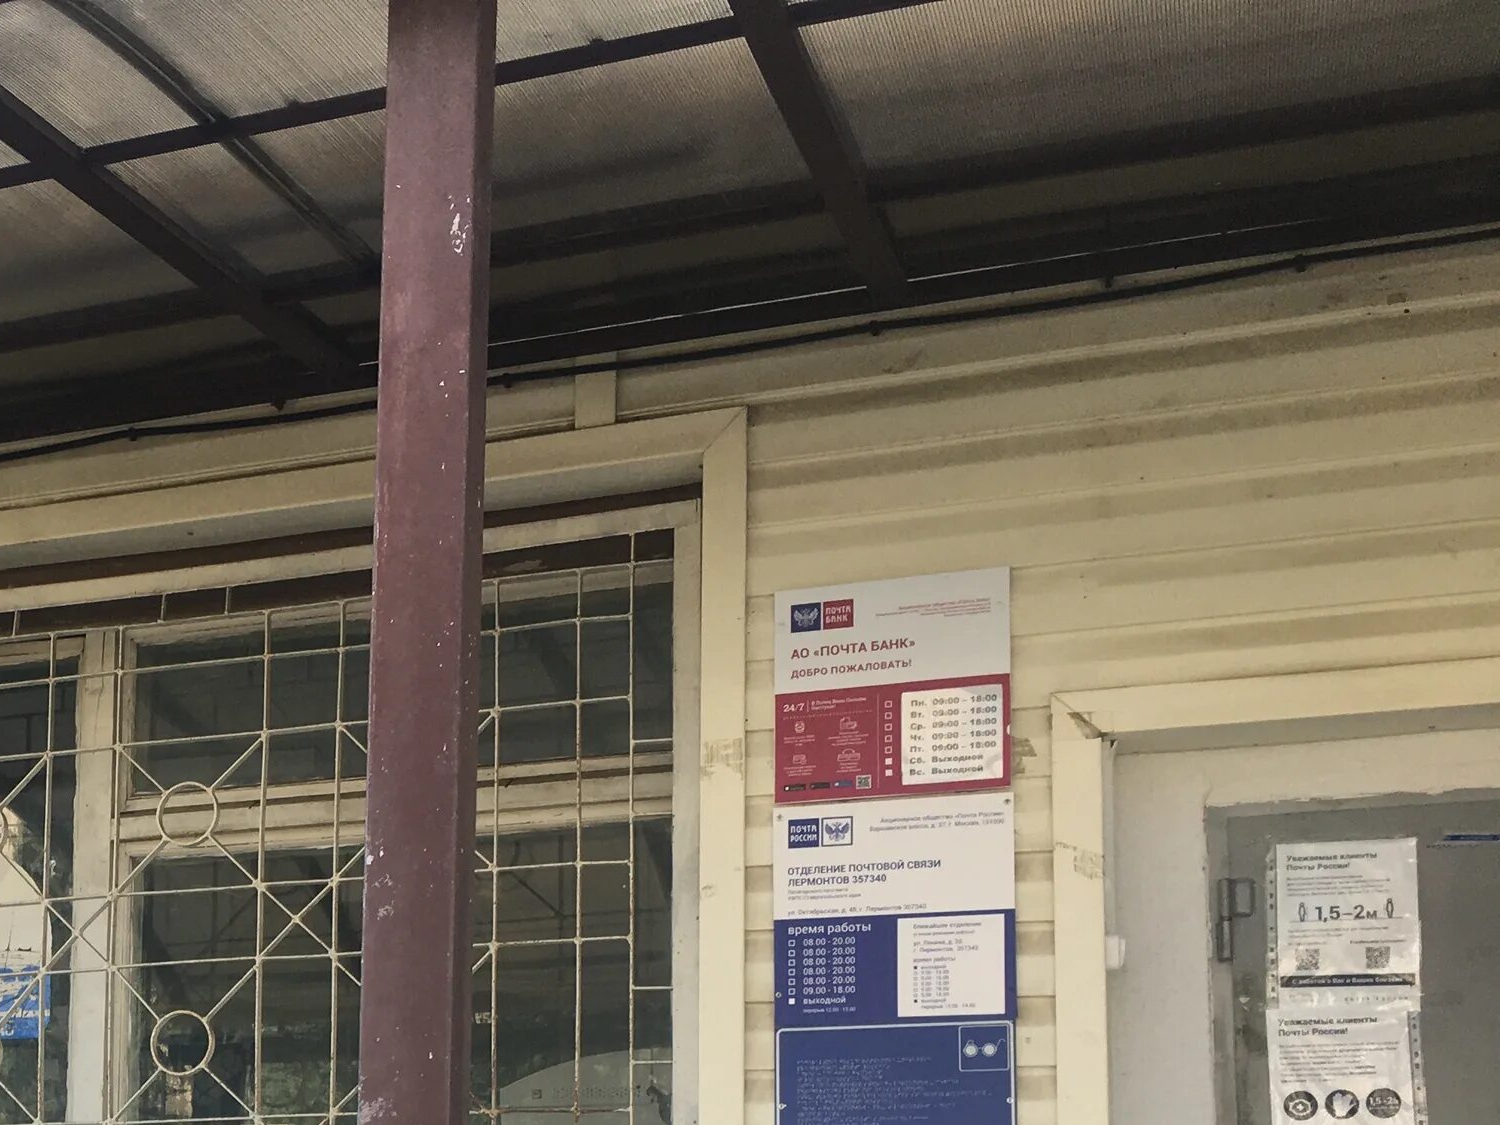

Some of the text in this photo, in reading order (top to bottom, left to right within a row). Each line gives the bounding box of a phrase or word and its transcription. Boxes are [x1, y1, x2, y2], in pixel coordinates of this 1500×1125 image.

[825, 605, 851, 615] ПОЧТА
[825, 614, 848, 624] БАНК
[790, 638, 916, 660] АО «ПОЧТА БАНК»
[790, 659, 912, 680] ДОБРО ПОЖАЛОВАТЬ!
[932, 697, 960, 705] 09:00
[783, 702, 805, 713] 24/7
[932, 766, 983, 775] Выходной
[790, 826, 817, 834] ПОЧТА
[790, 834, 817, 842] РОССИИ
[1286, 852, 1378, 862] Уважаемые клиенты
[788, 859, 941, 877] ОТДЕЛЕНИЕ ПОЧТОВОЙ СВЯЗИ
[1286, 862, 1351, 871] Почты России!
[788, 874, 887, 888] ЛЕРМОНТОВ 357340
[788, 922, 872, 936] время работы
[803, 938, 827, 946] 08.00
[832, 936, 856, 944] 20.00
[803, 948, 827, 956] 08.00
[832, 947, 856, 955] 20.00
[803, 958, 827, 966] 08.00
[832, 956, 856, 964] 20.00
[803, 967, 827, 975] 08.00
[832, 966, 856, 974] 20.00
[803, 977, 827, 985] 08.00
[803, 987, 827, 995] 09.00
[832, 986, 856, 994] 18.00
[803, 996, 846, 1005] выходной
[1278, 1017, 1378, 1027] Уважаемые клиенты
[1278, 1027, 1349, 1037] Почты России!
